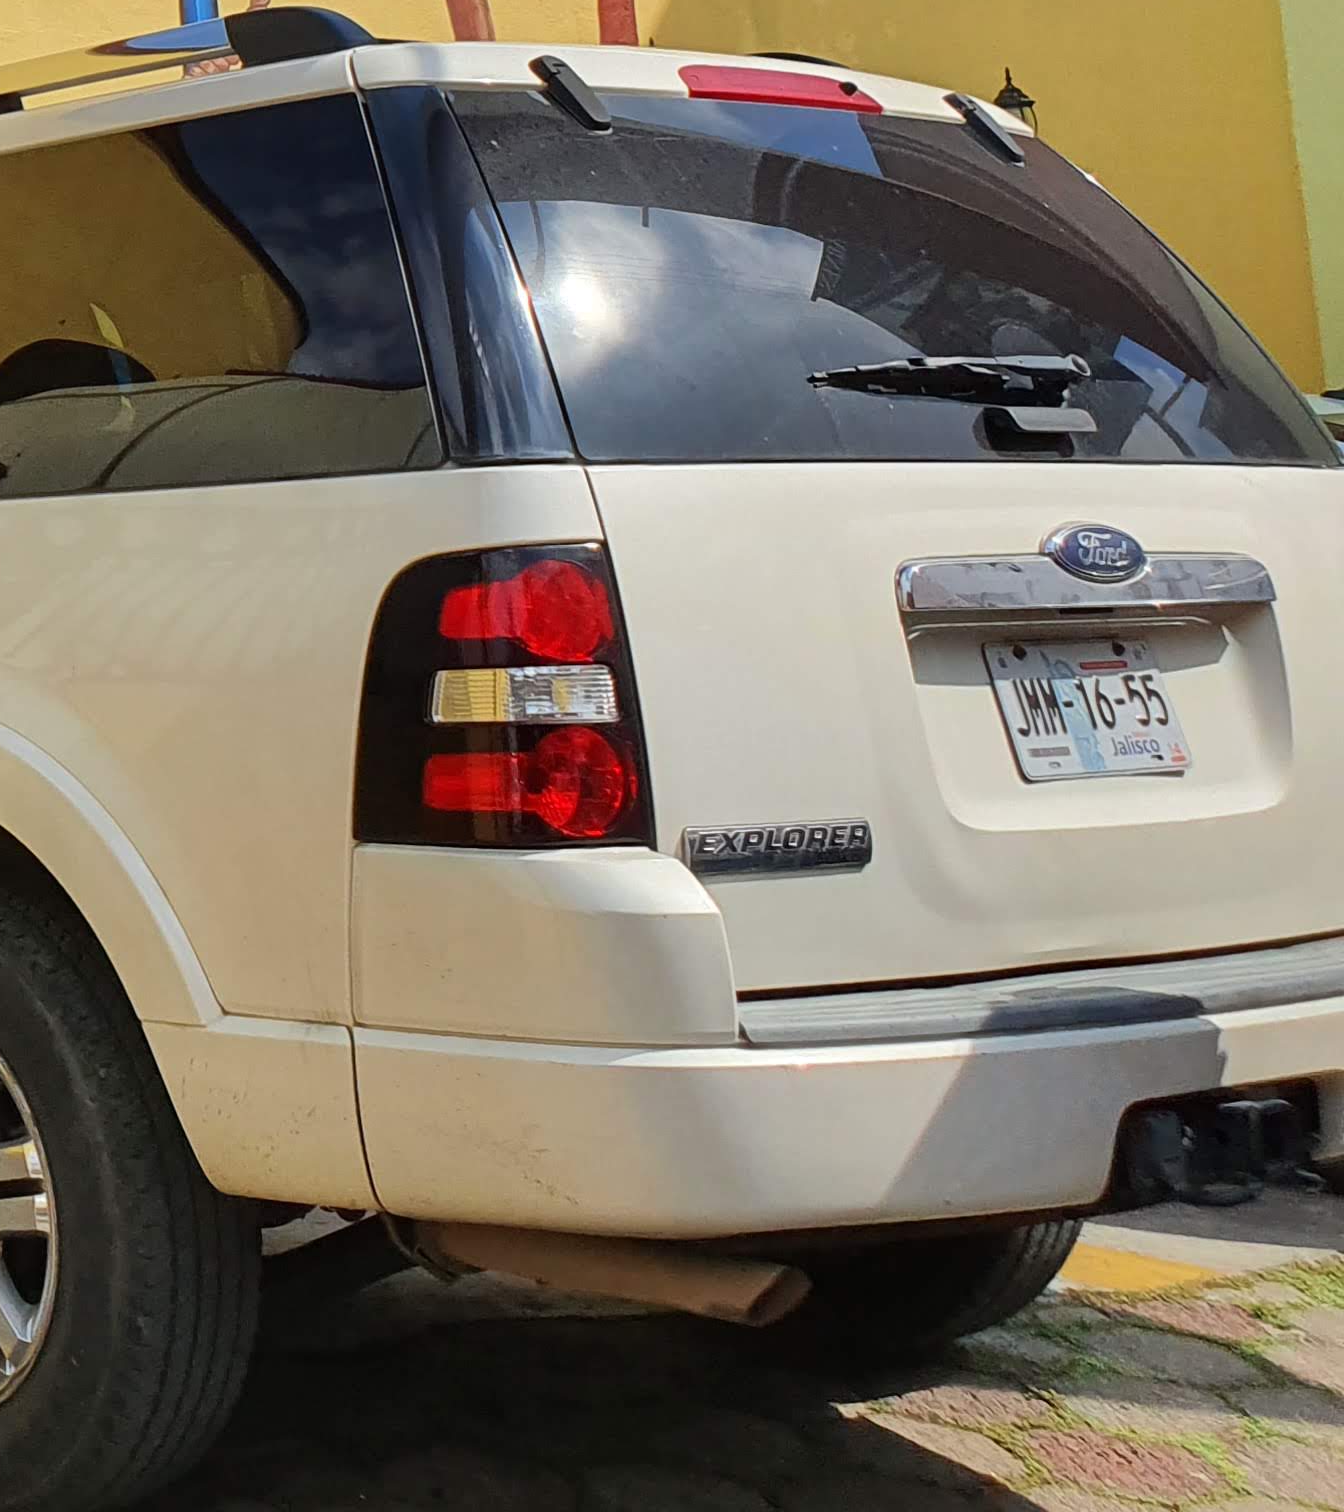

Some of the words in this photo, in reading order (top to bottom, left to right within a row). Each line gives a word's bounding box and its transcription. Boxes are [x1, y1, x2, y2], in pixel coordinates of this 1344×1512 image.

[1076, 530, 1131, 567] Ford
[1011, 673, 1170, 738] JMM-16-55
[1112, 734, 1161, 757] Jalisco
[695, 824, 868, 855] EXPLORER
